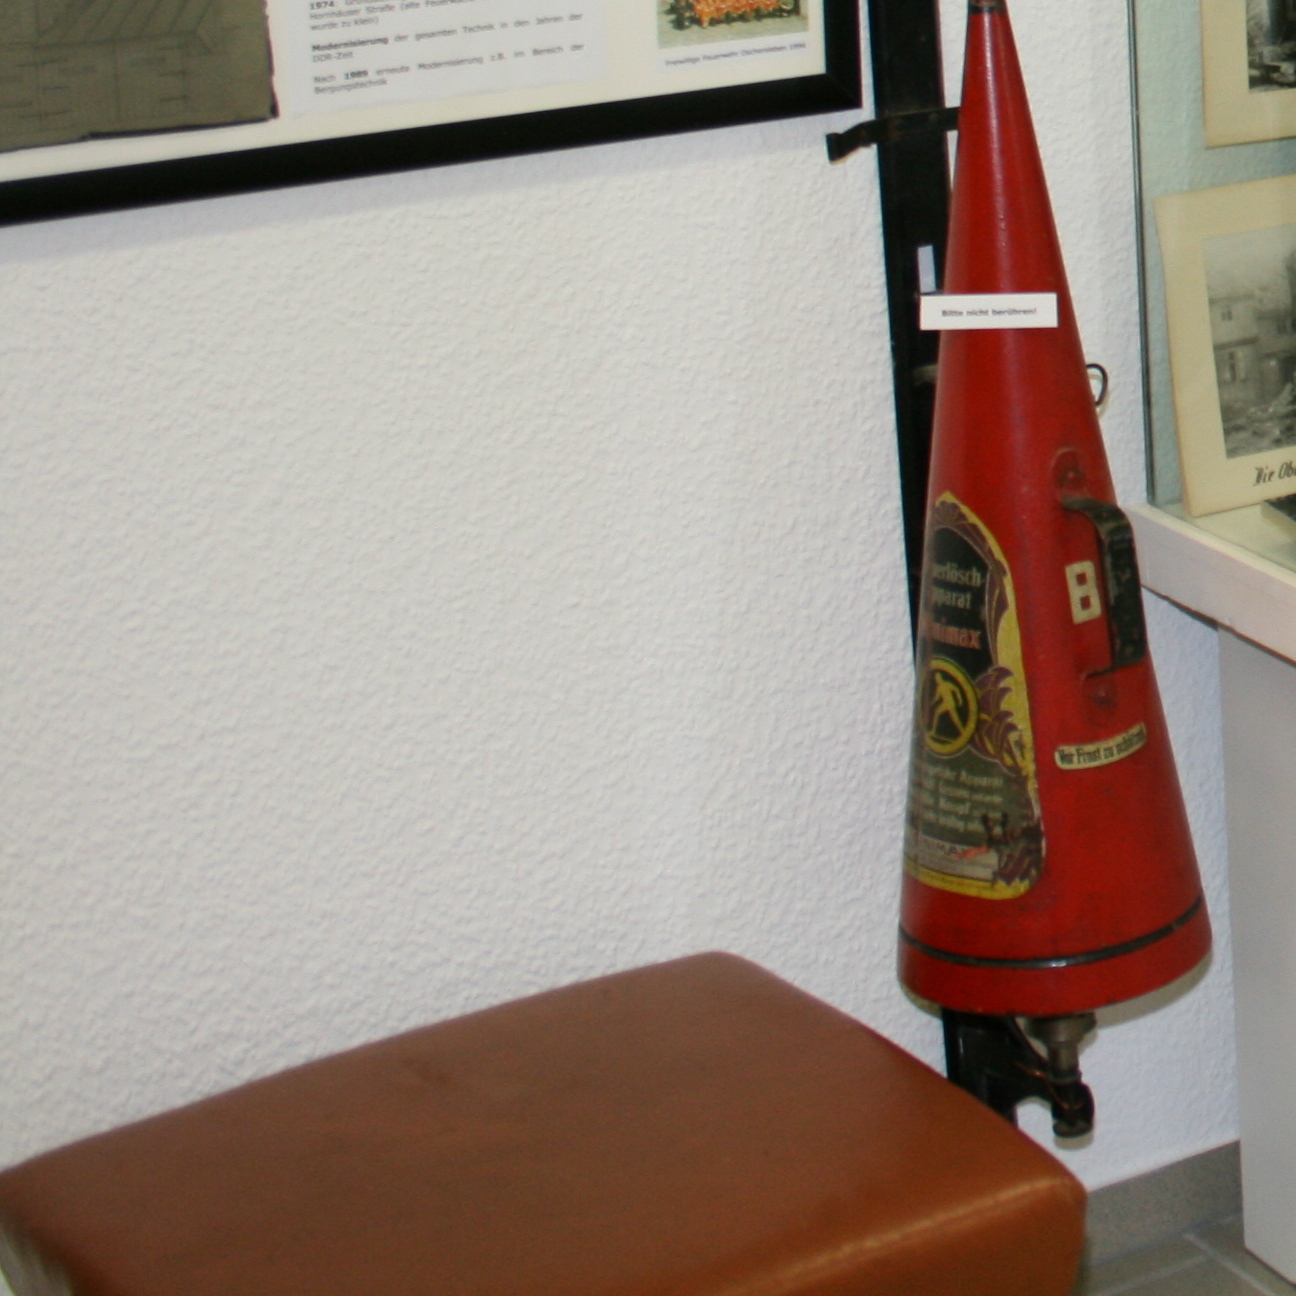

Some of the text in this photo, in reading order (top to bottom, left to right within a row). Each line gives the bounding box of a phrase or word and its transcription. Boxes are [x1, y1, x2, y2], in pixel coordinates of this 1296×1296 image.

[312, 36, 390, 53] Modernisierung
[942, 308, 1037, 317] Bitte nicht berühren!
[1252, 466, 1276, 486] Die
